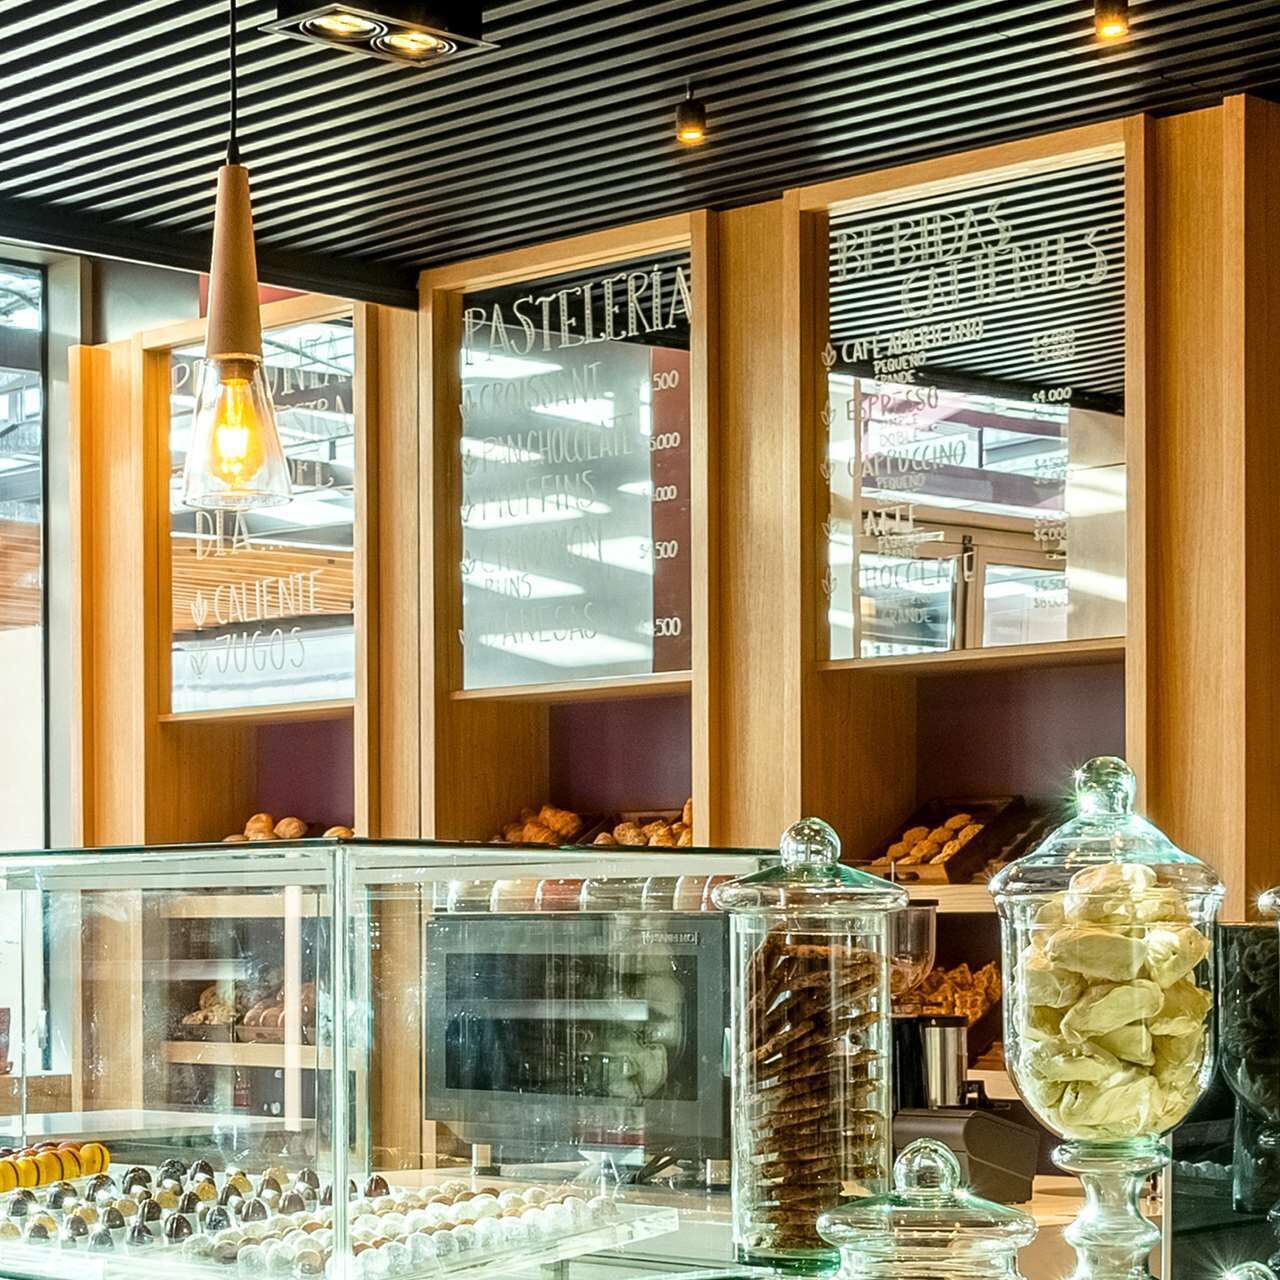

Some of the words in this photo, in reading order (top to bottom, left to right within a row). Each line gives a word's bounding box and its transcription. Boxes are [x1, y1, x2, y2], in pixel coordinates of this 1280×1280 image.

[835, 199, 1012, 282] BEBIDAS
[463, 265, 691, 365] PASTELERÍA
[480, 362, 603, 418] CROISSANT
[847, 440, 967, 478] CAPPUCCINO
[213, 570, 324, 625] CALIENTE
[215, 626, 306, 674] JUGOS
